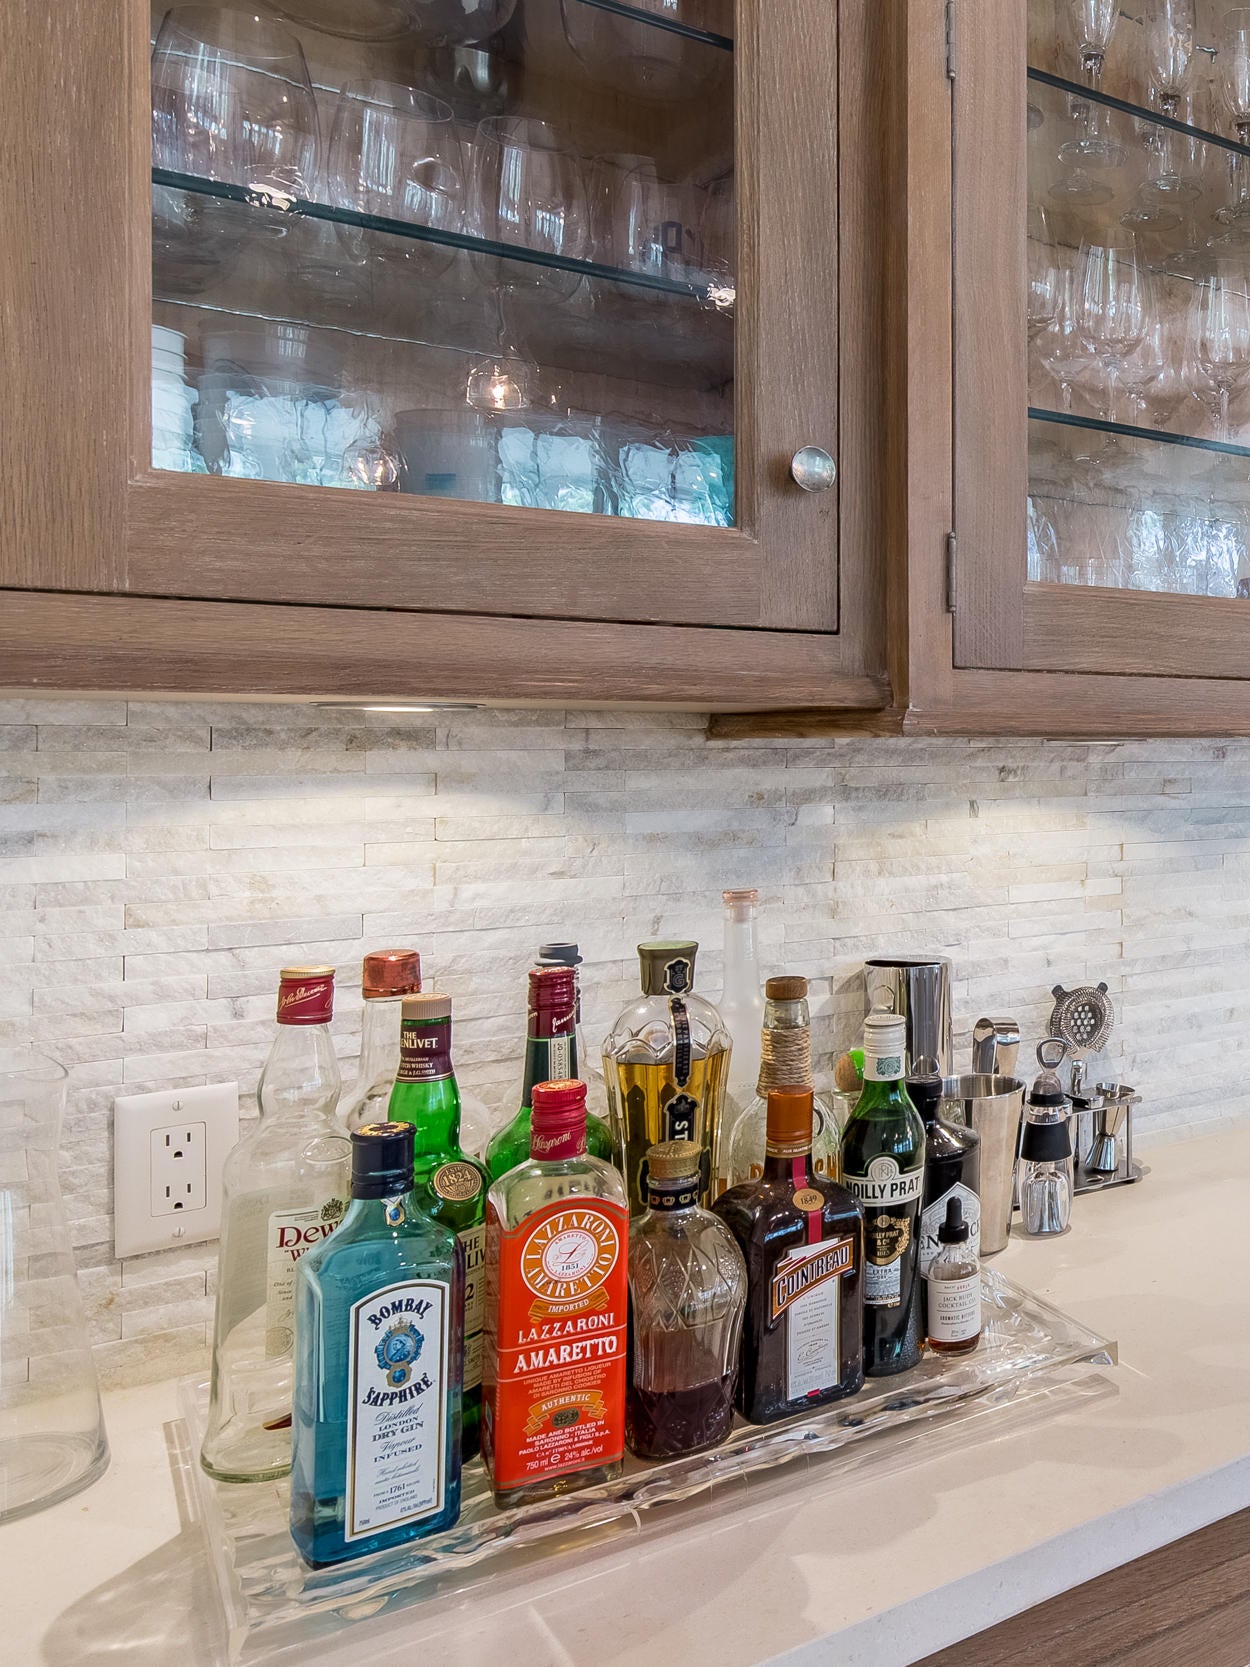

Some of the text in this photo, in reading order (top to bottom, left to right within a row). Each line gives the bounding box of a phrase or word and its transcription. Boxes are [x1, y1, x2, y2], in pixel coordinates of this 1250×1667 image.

[890, 1176, 920, 1198] PRAT
[276, 1220, 344, 1248] Dew
[526, 1213, 615, 1260] LAZZARONI
[777, 1246, 849, 1307] COINTREAU
[367, 1298, 433, 1331] BOMBAY
[548, 1298, 590, 1313] IMPORTED
[518, 1312, 614, 1344] LAZZARONI
[513, 1335, 618, 1374] AMARETTO
[362, 1372, 433, 1407] SAPPHIRE
[541, 1393, 591, 1412] AUTHENTIC
[372, 1420, 424, 1442] DRY GIN
[379, 1416, 419, 1432] LONDON
[526, 1433, 547, 1443] MADE
[547, 1429, 563, 1437] AND
[564, 1422, 596, 1433] BOTTLED
[534, 1434, 569, 1446] SARONNO
[574, 1428, 597, 1436] ITALIA
[374, 1443, 423, 1463] INFUSED
[526, 1460, 539, 1470] 750
[540, 1459, 548, 1467] ml
[564, 1450, 580, 1461] 24%
[390, 1483, 406, 1494] 1761
